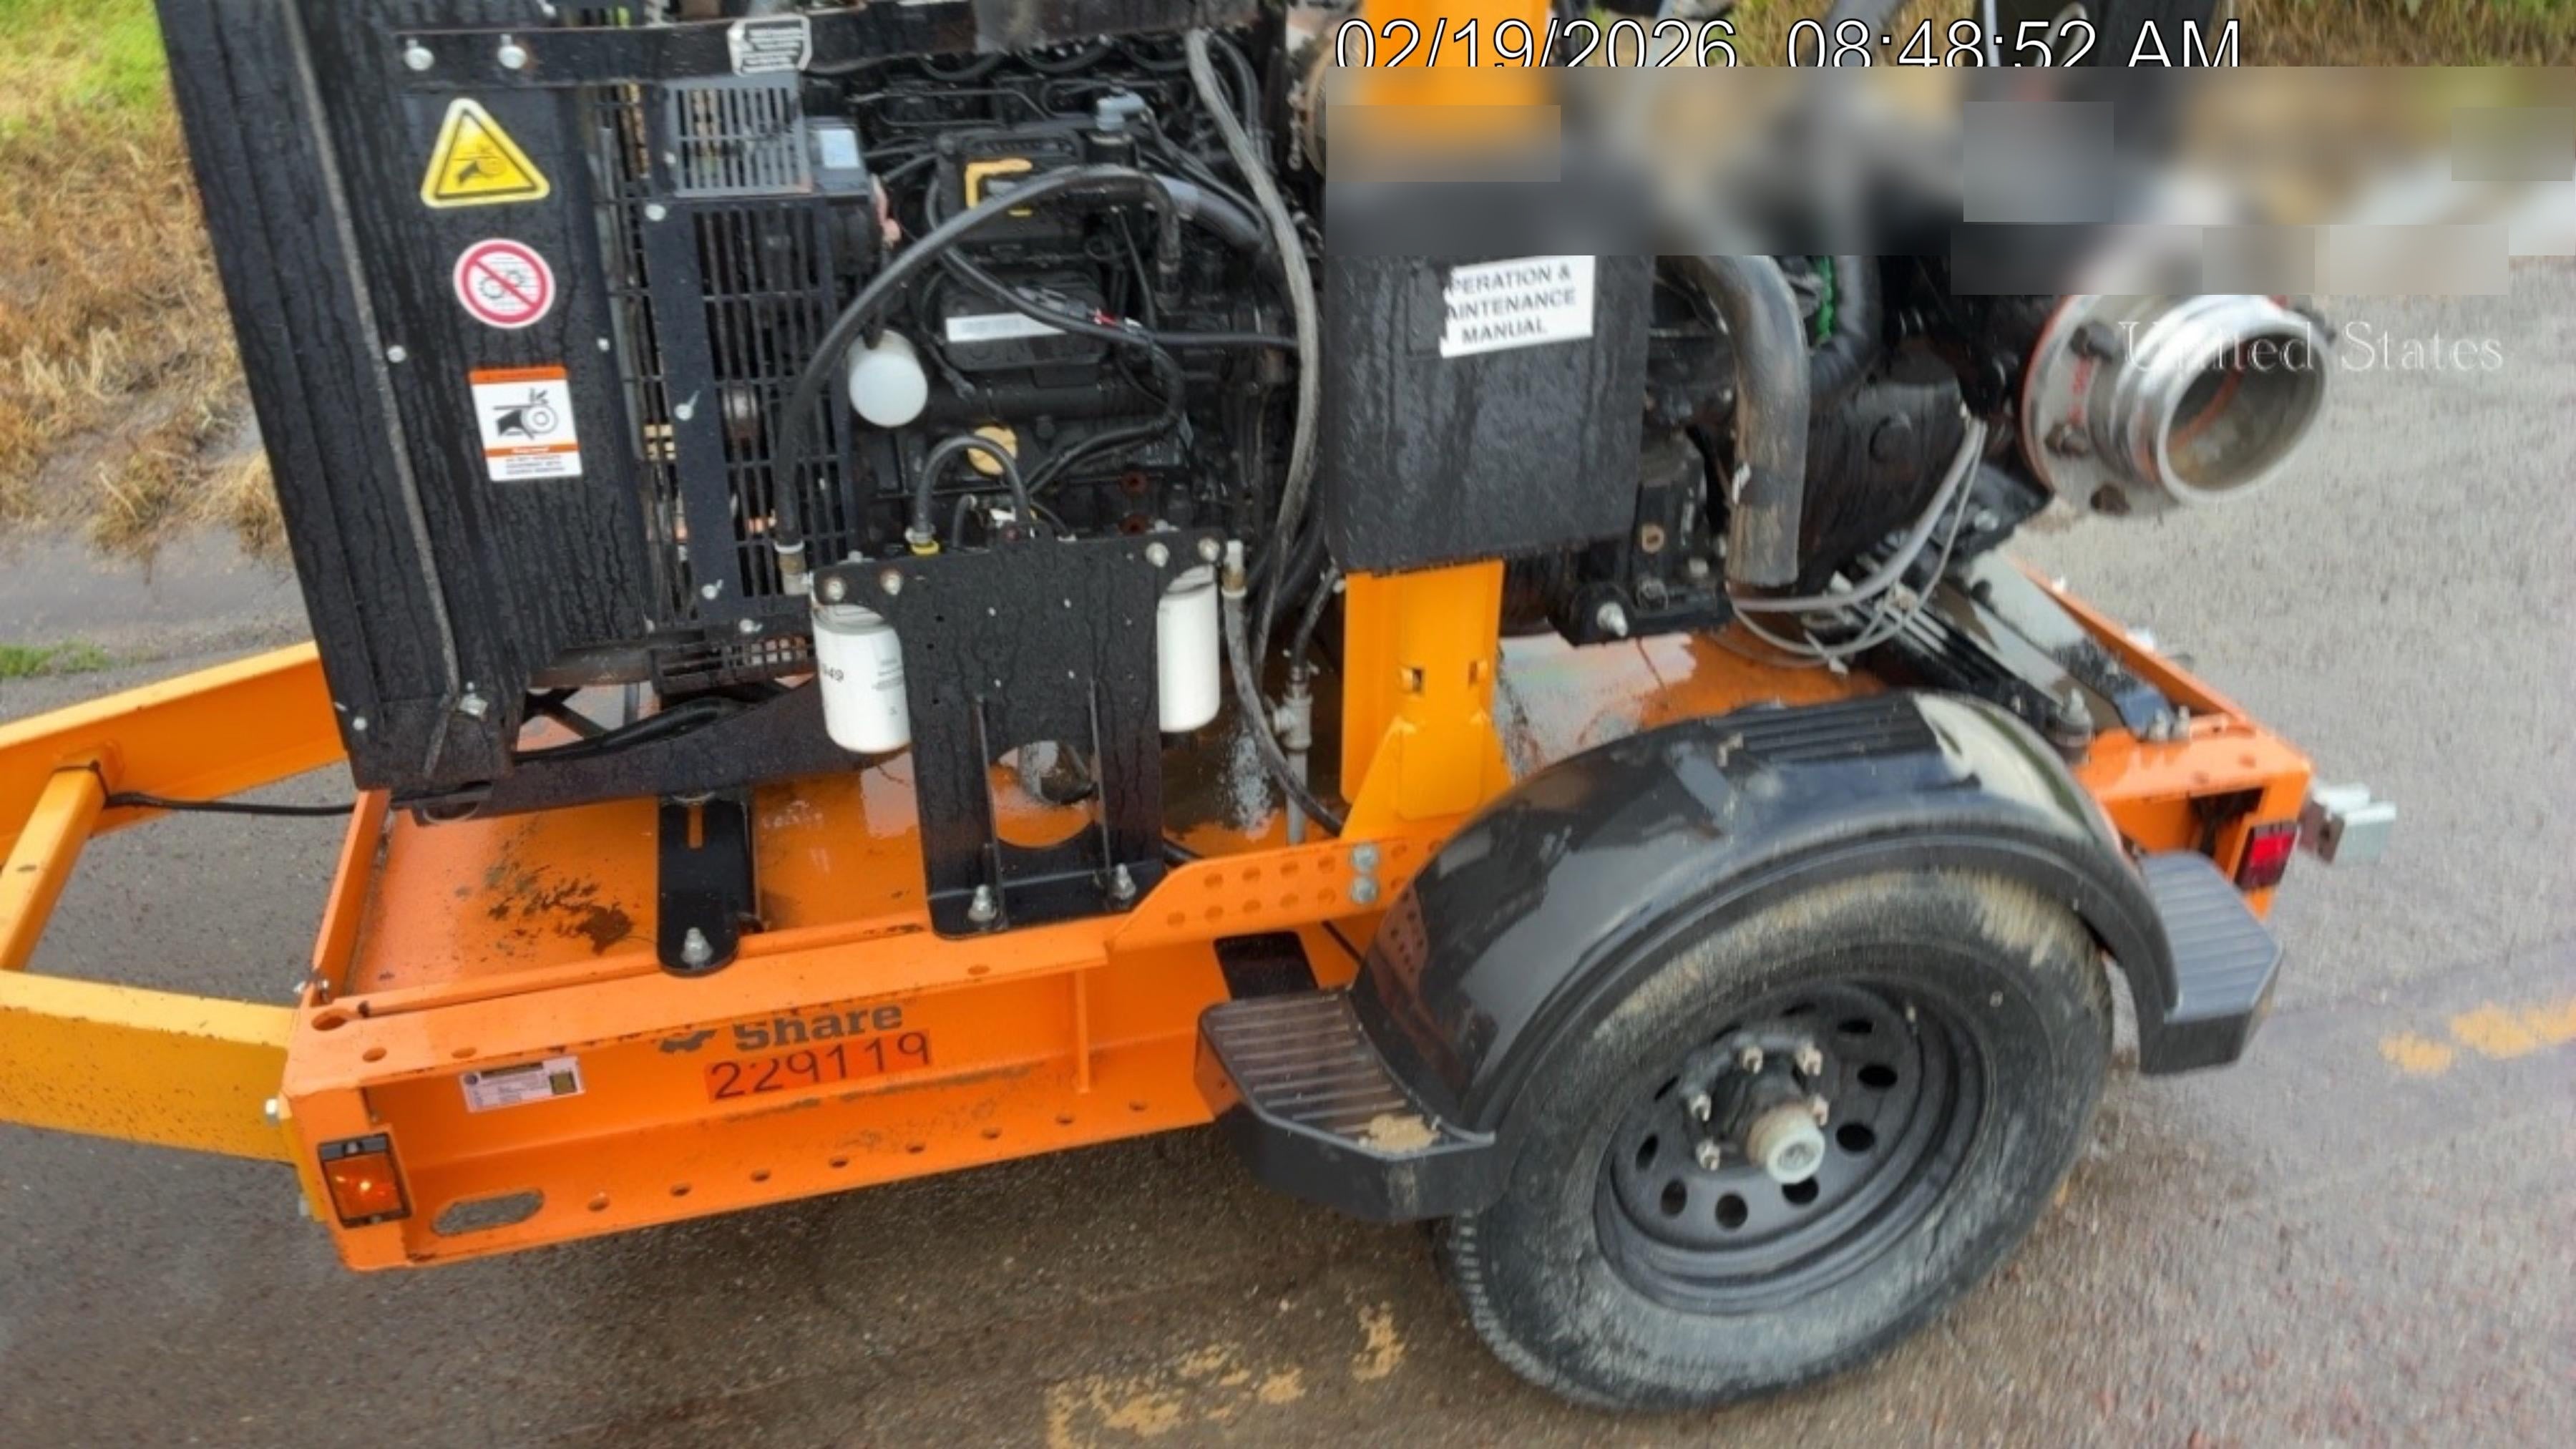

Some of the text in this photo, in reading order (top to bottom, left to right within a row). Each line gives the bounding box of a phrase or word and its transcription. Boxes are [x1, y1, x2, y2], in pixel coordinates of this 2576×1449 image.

[1453, 265, 1571, 293] PERATION &
[1448, 288, 1576, 320] AINTENANCE
[1462, 316, 1546, 343] MANUAL
[732, 1003, 904, 1051] Share
[711, 1030, 931, 1101] 229119
